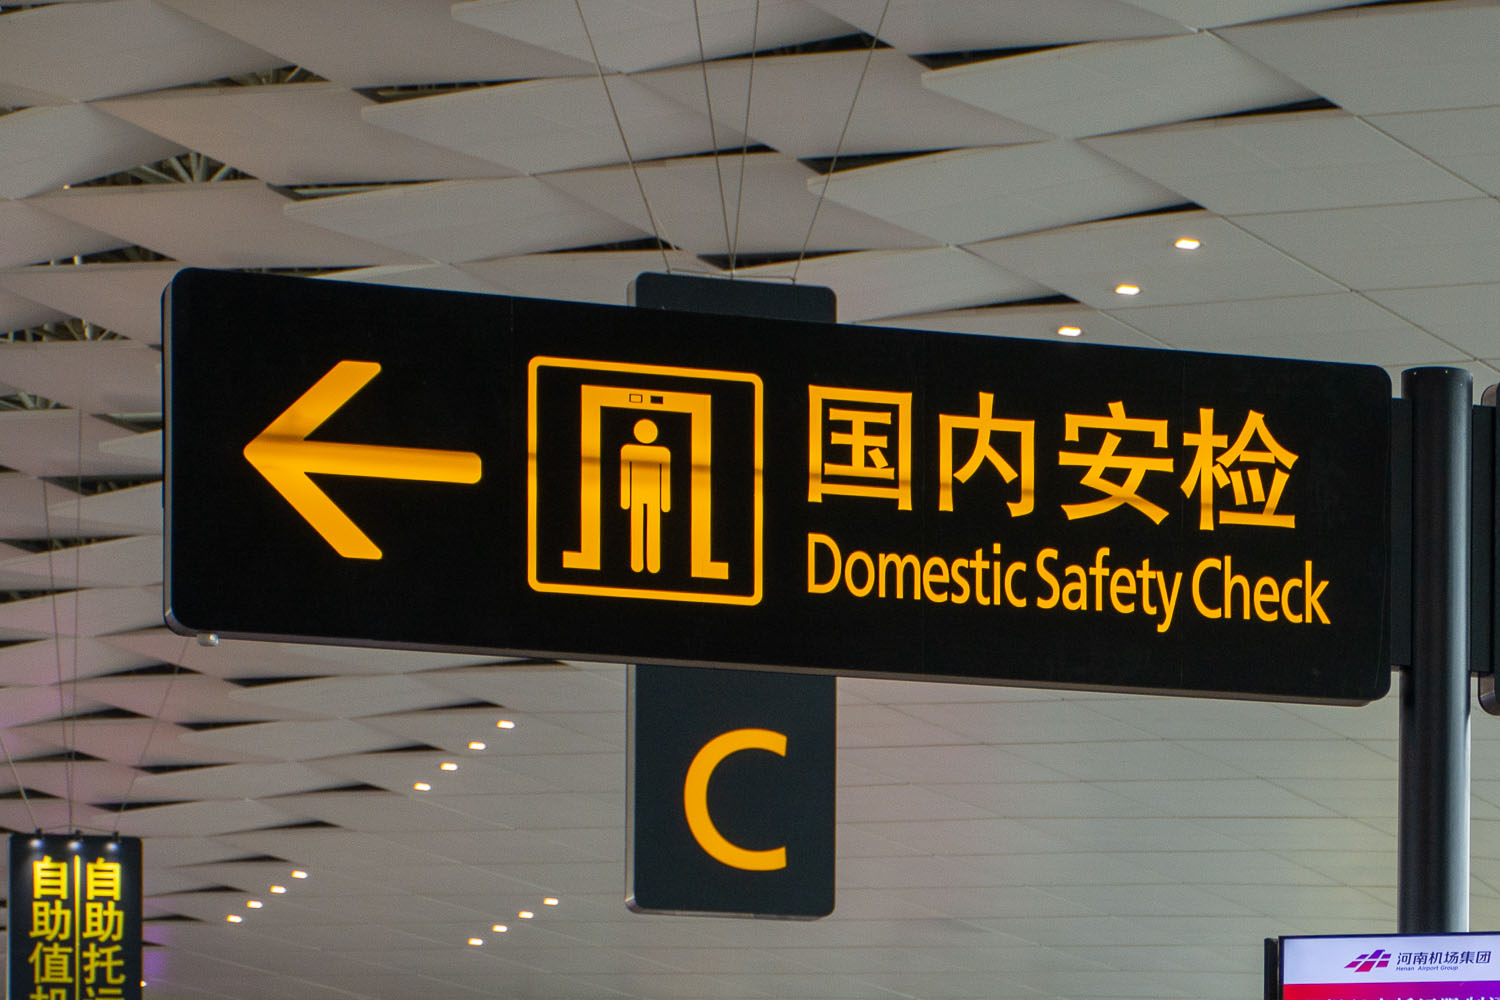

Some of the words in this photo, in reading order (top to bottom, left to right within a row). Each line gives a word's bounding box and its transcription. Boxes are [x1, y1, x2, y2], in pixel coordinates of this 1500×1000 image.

[808, 384, 1299, 531] 国内安检
[807, 532, 1027, 607] Domestic
[1036, 547, 1183, 633] Safety
[1192, 555, 1331, 624] Check
[684, 728, 787, 871] C
[1397, 951, 1492, 965] 河南机场集团
